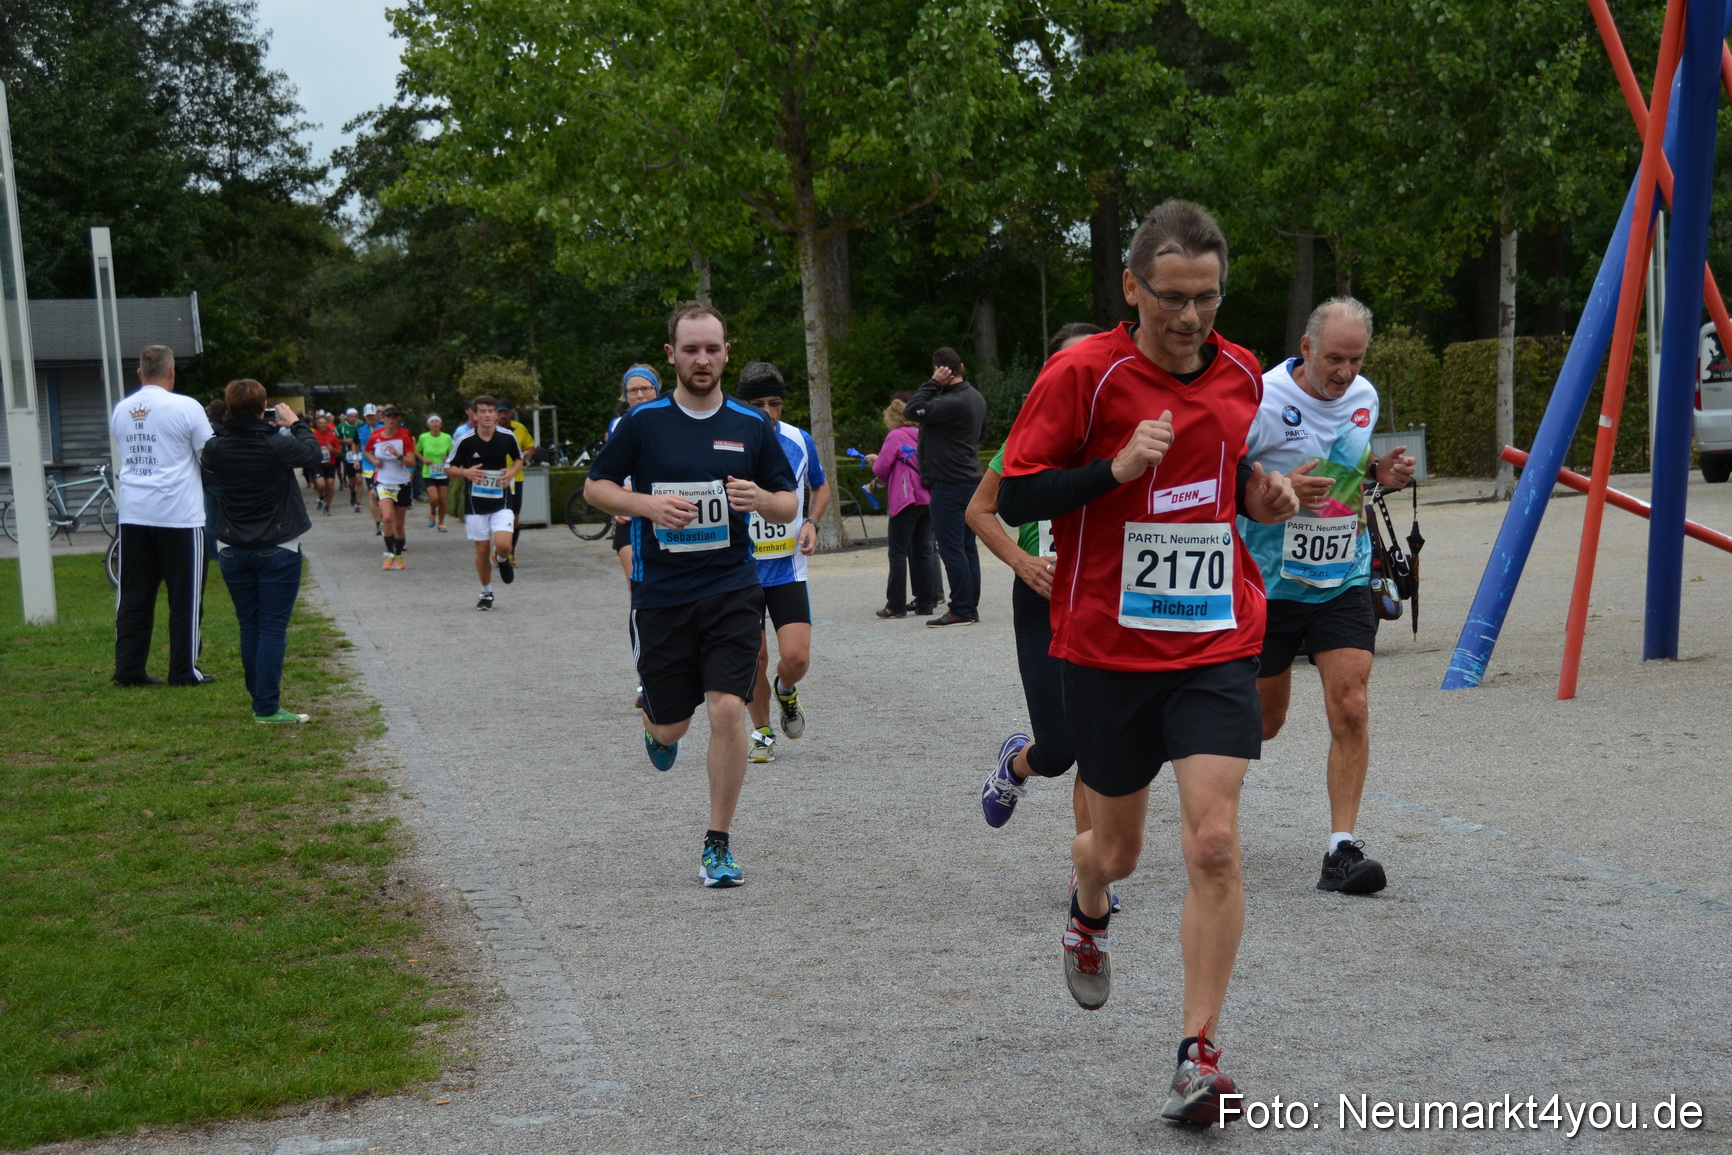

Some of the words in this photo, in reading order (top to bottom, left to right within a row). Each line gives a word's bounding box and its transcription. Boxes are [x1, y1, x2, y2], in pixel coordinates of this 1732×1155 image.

[135, 422, 144, 430] IM
[126, 433, 157, 443] AUFTRAG
[1285, 429, 1308, 437] PARTL
[129, 445, 153, 454] SEINER
[131, 468, 153, 477] JESUS
[1171, 490, 1200, 504] DEHN
[752, 520, 787, 540] 155
[1287, 521, 1314, 532] PARTL
[1316, 523, 1350, 532] Neumarkt
[666, 530, 716, 543] Sebastian
[1128, 532, 1168, 544] PARTL
[1170, 534, 1220, 545] Neumarkt
[755, 542, 787, 553] Bernhard
[1291, 533, 1352, 562] 3057
[1134, 549, 1225, 590] 2170
[1151, 600, 1208, 616] Richard
